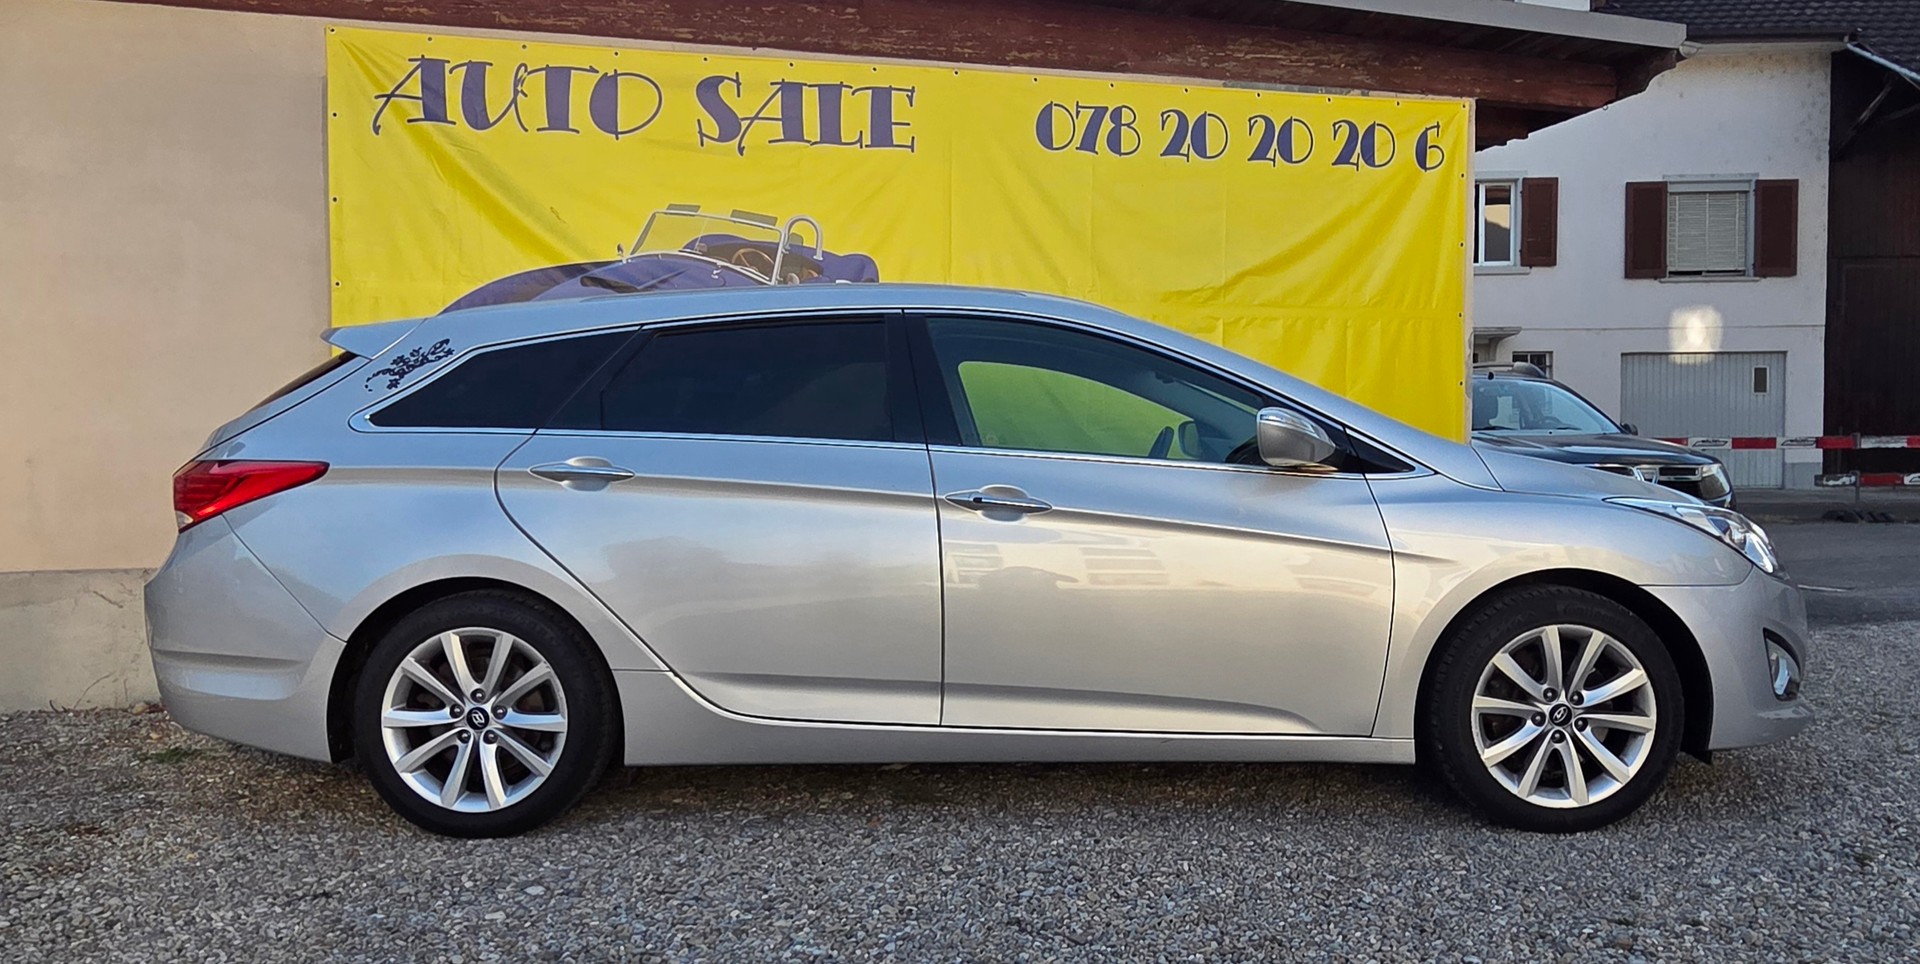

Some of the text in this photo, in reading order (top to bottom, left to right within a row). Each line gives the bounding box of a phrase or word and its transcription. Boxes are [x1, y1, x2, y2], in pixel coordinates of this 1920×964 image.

[372, 54, 916, 156] AUTO SALE
[1035, 101, 1445, 172] 078 20 20 20 6
